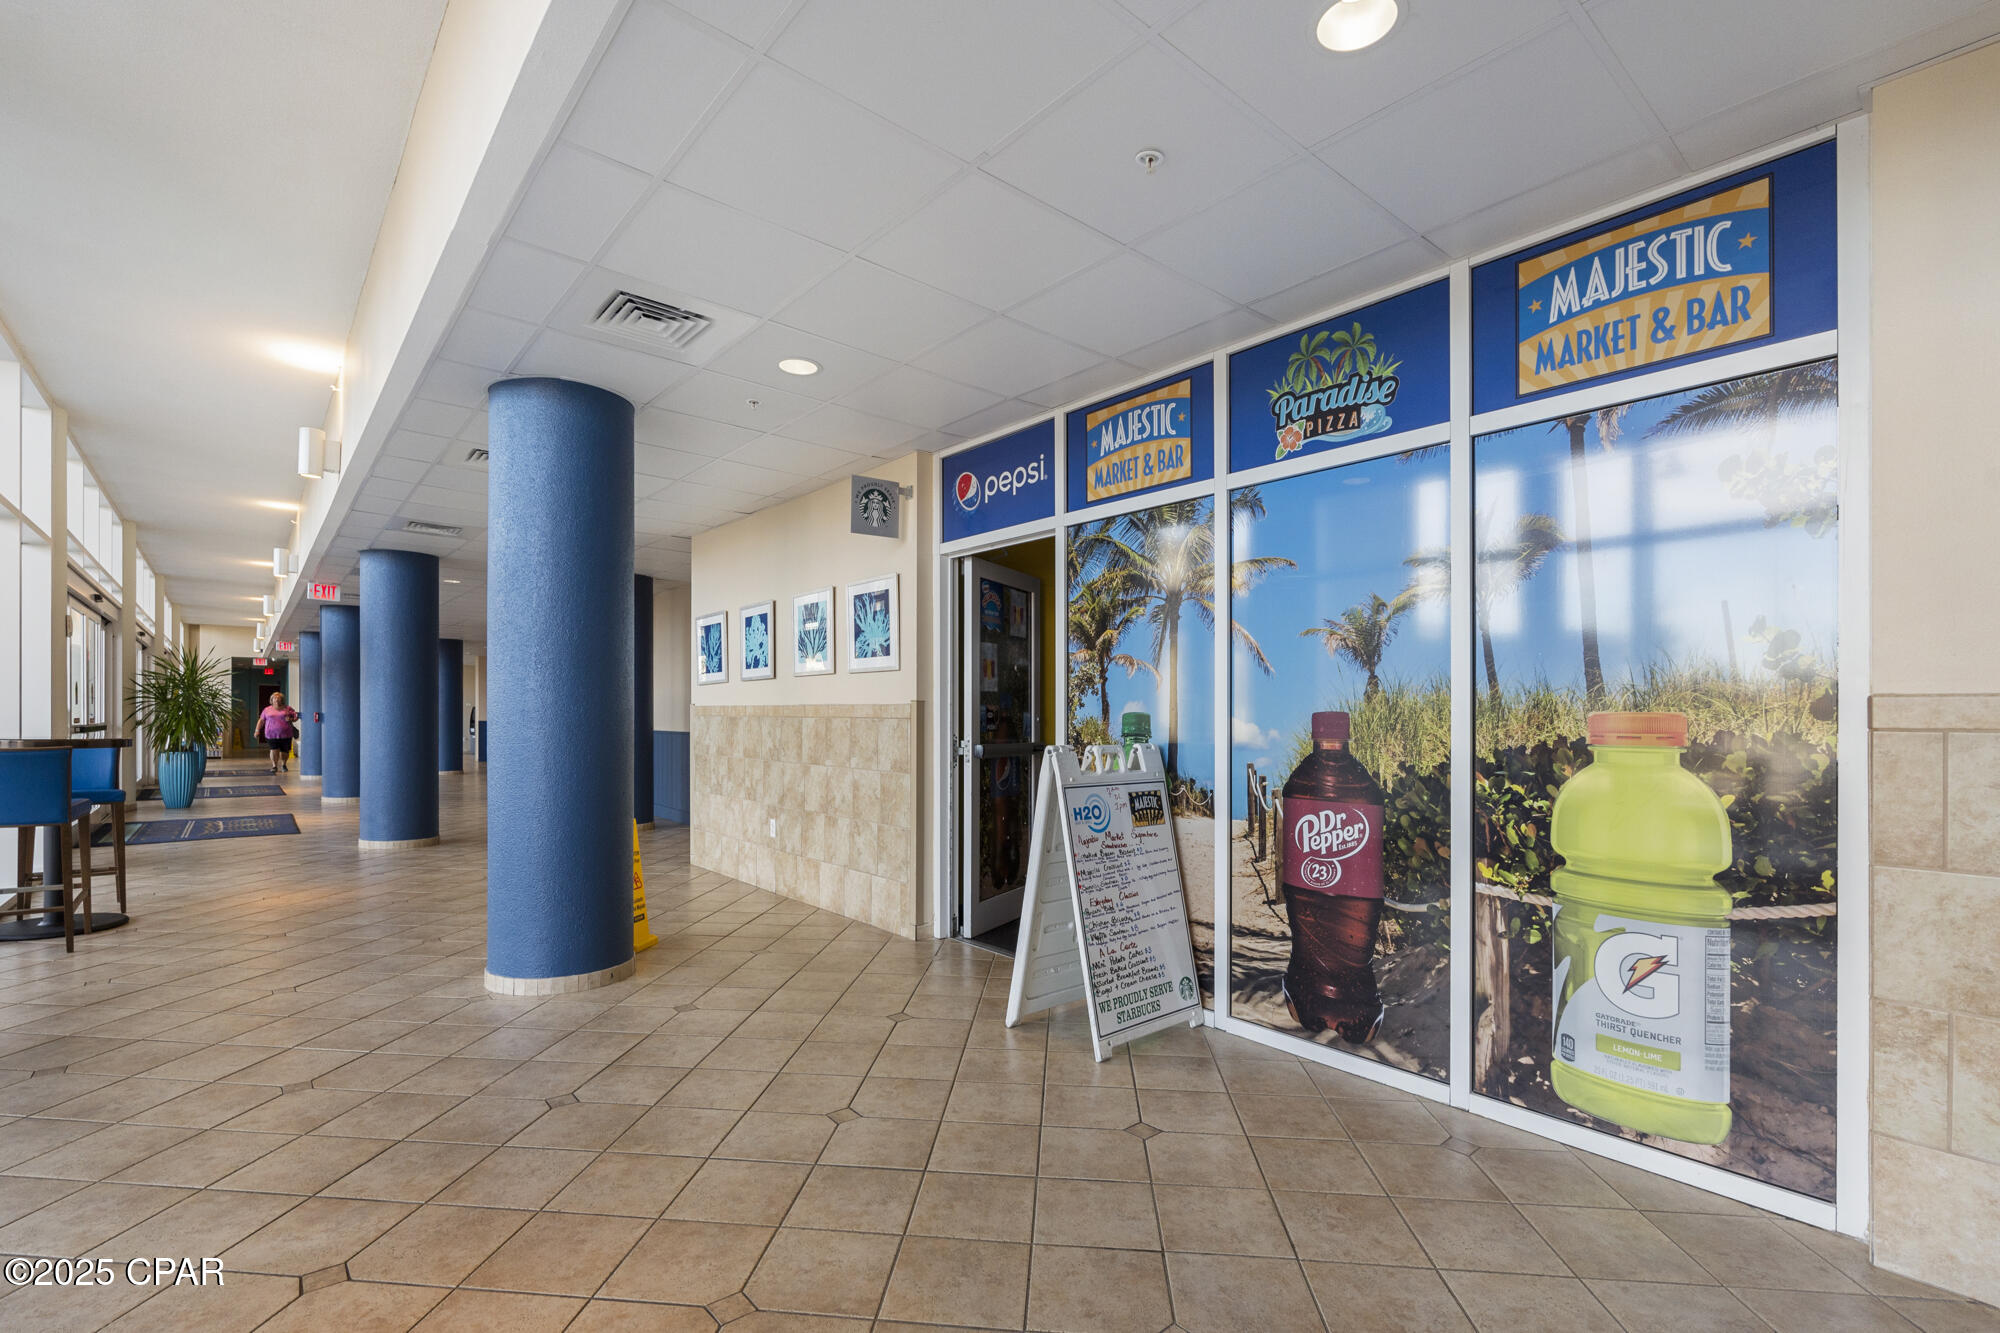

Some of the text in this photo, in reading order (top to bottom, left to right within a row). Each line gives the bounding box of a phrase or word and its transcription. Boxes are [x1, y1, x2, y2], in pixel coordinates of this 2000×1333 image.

[1548, 220, 1733, 325] MAJESTIC
[1534, 284, 1752, 376] MARKET & BAR
[1274, 374, 1396, 427] Paradise
[1099, 401, 1177, 457] MAJESTIC
[1305, 411, 1359, 438] PIZZA
[984, 454, 1045, 504] pepsi
[1093, 444, 1185, 490] MARKET & BAR
[313, 583, 337, 601] EXIT
[279, 641, 292, 651] EXIT
[1073, 804, 1102, 821] H2O
[1319, 809, 1347, 834] Dr
[1295, 814, 1364, 855] Pepper
[1311, 863, 1328, 880] 23
[1099, 941, 1138, 959] A La Carte
[1128, 949, 1144, 960] Cakes
[1120, 979, 1138, 989] Cream
[1138, 972, 1158, 982] Cheese
[1594, 931, 1680, 1019] G
[1098, 980, 1174, 1014] WE PROUDLY SERVE
[1116, 1000, 1161, 1025] STARBUCKS
[1595, 1012, 1636, 1027] GATORADE
[1596, 1019, 1682, 1046] THIRST QUENCHER
